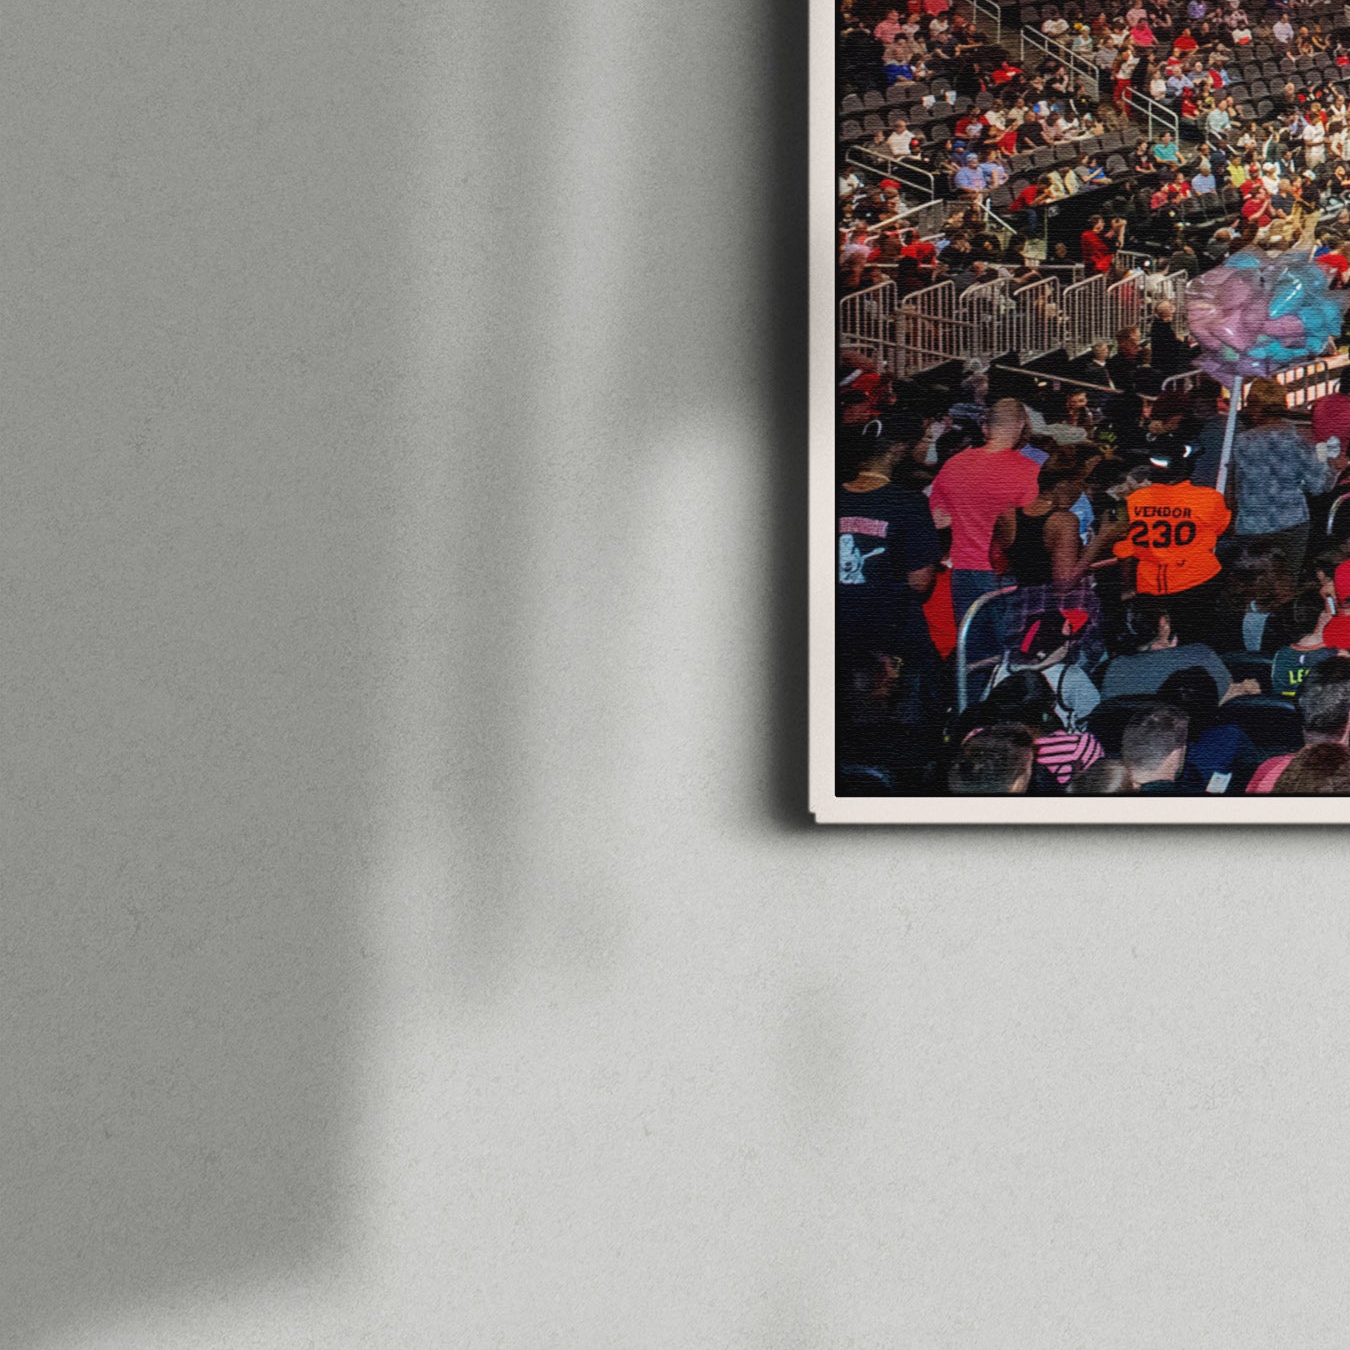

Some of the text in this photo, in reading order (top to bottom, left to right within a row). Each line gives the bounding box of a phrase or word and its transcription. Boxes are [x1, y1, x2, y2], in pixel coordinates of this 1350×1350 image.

[1133, 506, 1192, 519] VENDOR
[1129, 520, 1197, 548] 230
[1289, 668, 1310, 685] LE
